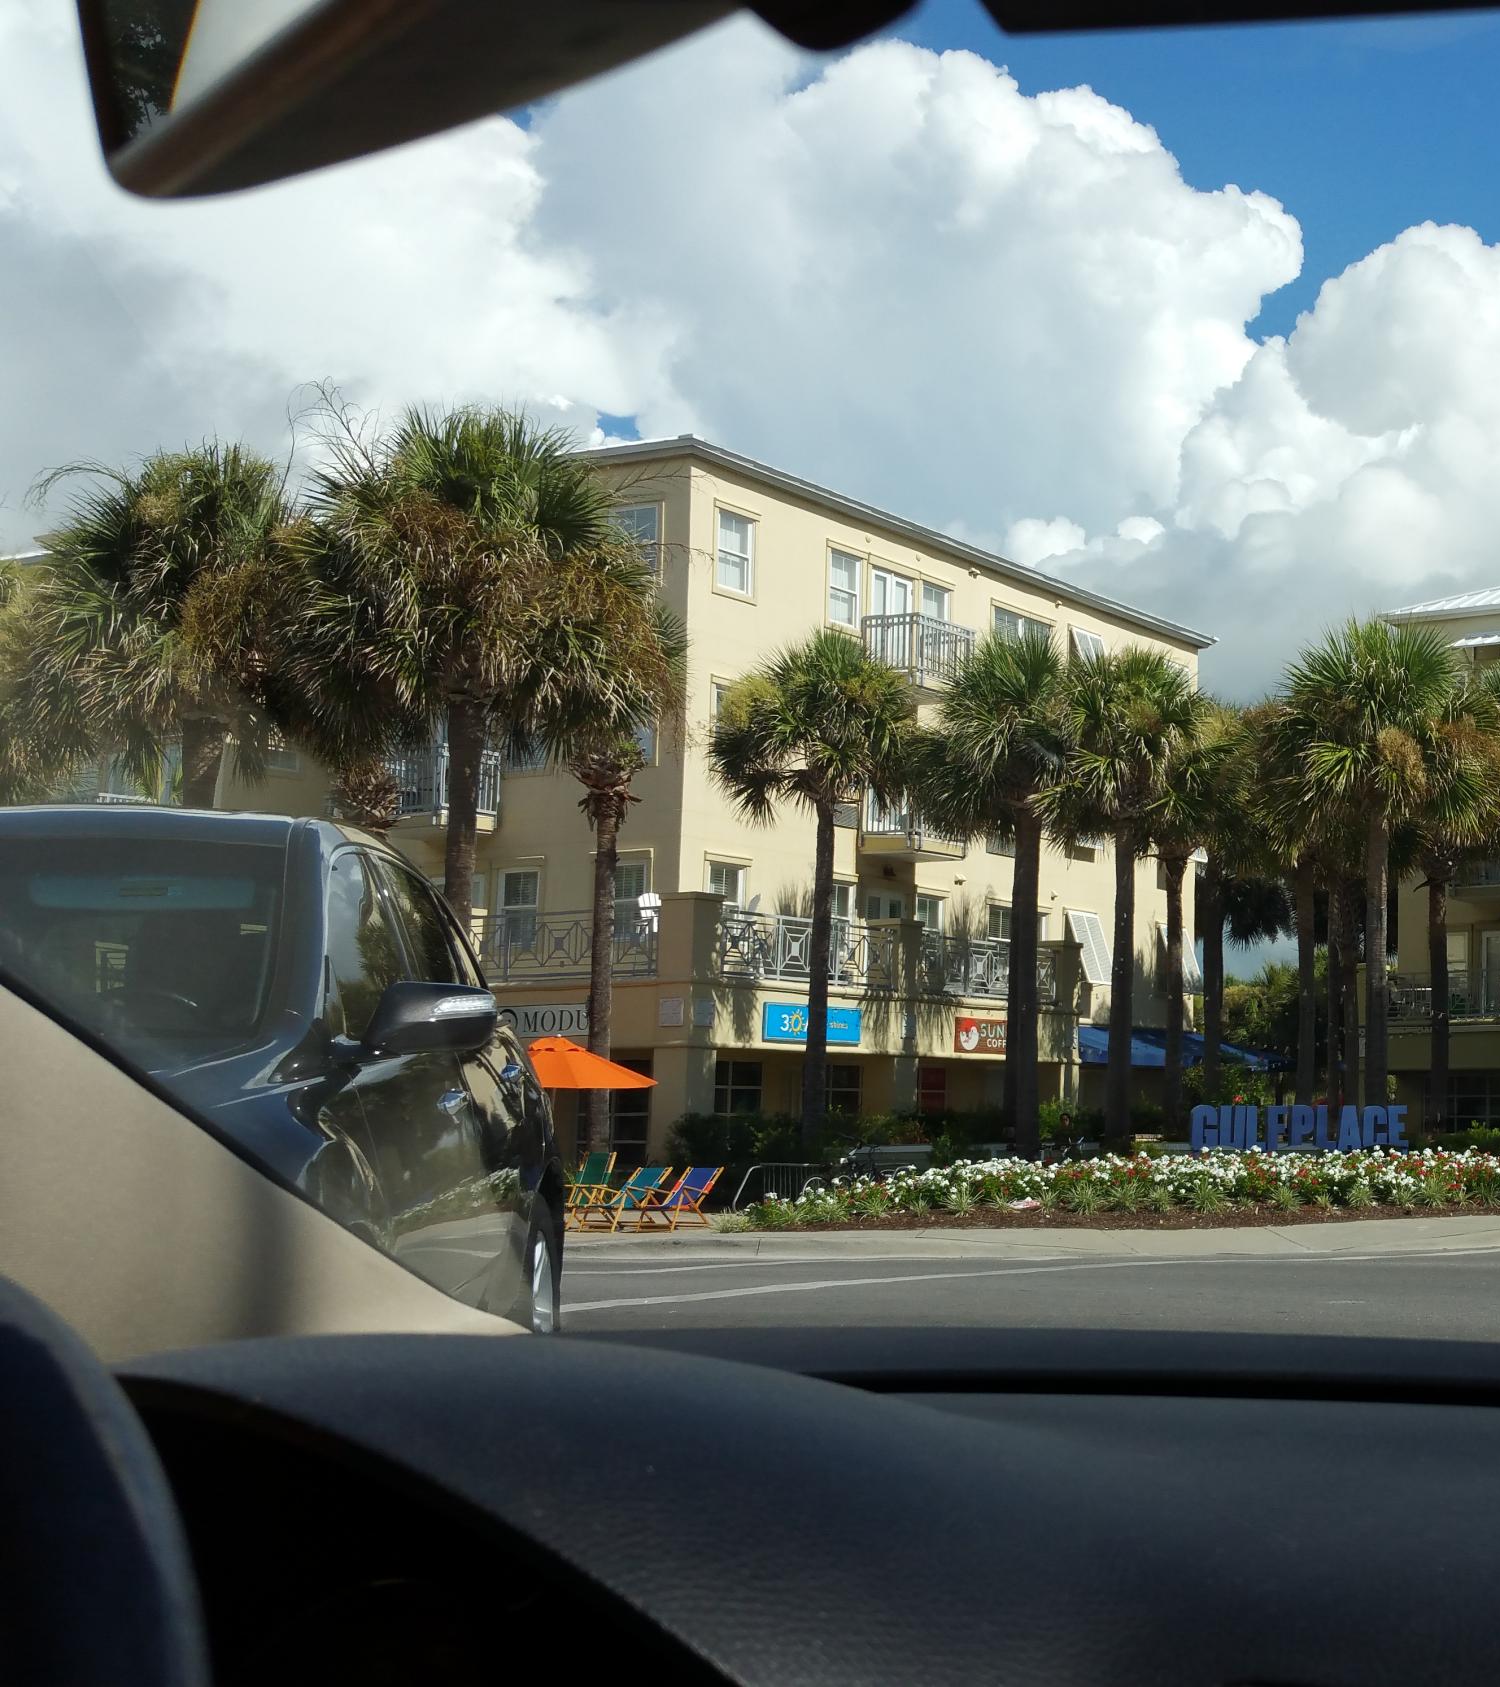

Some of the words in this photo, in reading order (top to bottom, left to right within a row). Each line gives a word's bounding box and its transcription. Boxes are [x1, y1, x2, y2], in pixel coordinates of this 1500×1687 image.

[523, 1009, 589, 1033] MODU
[780, 1013, 808, 1033] 30
[980, 1023, 1006, 1039] SUN
[986, 1038, 1007, 1049] COFF
